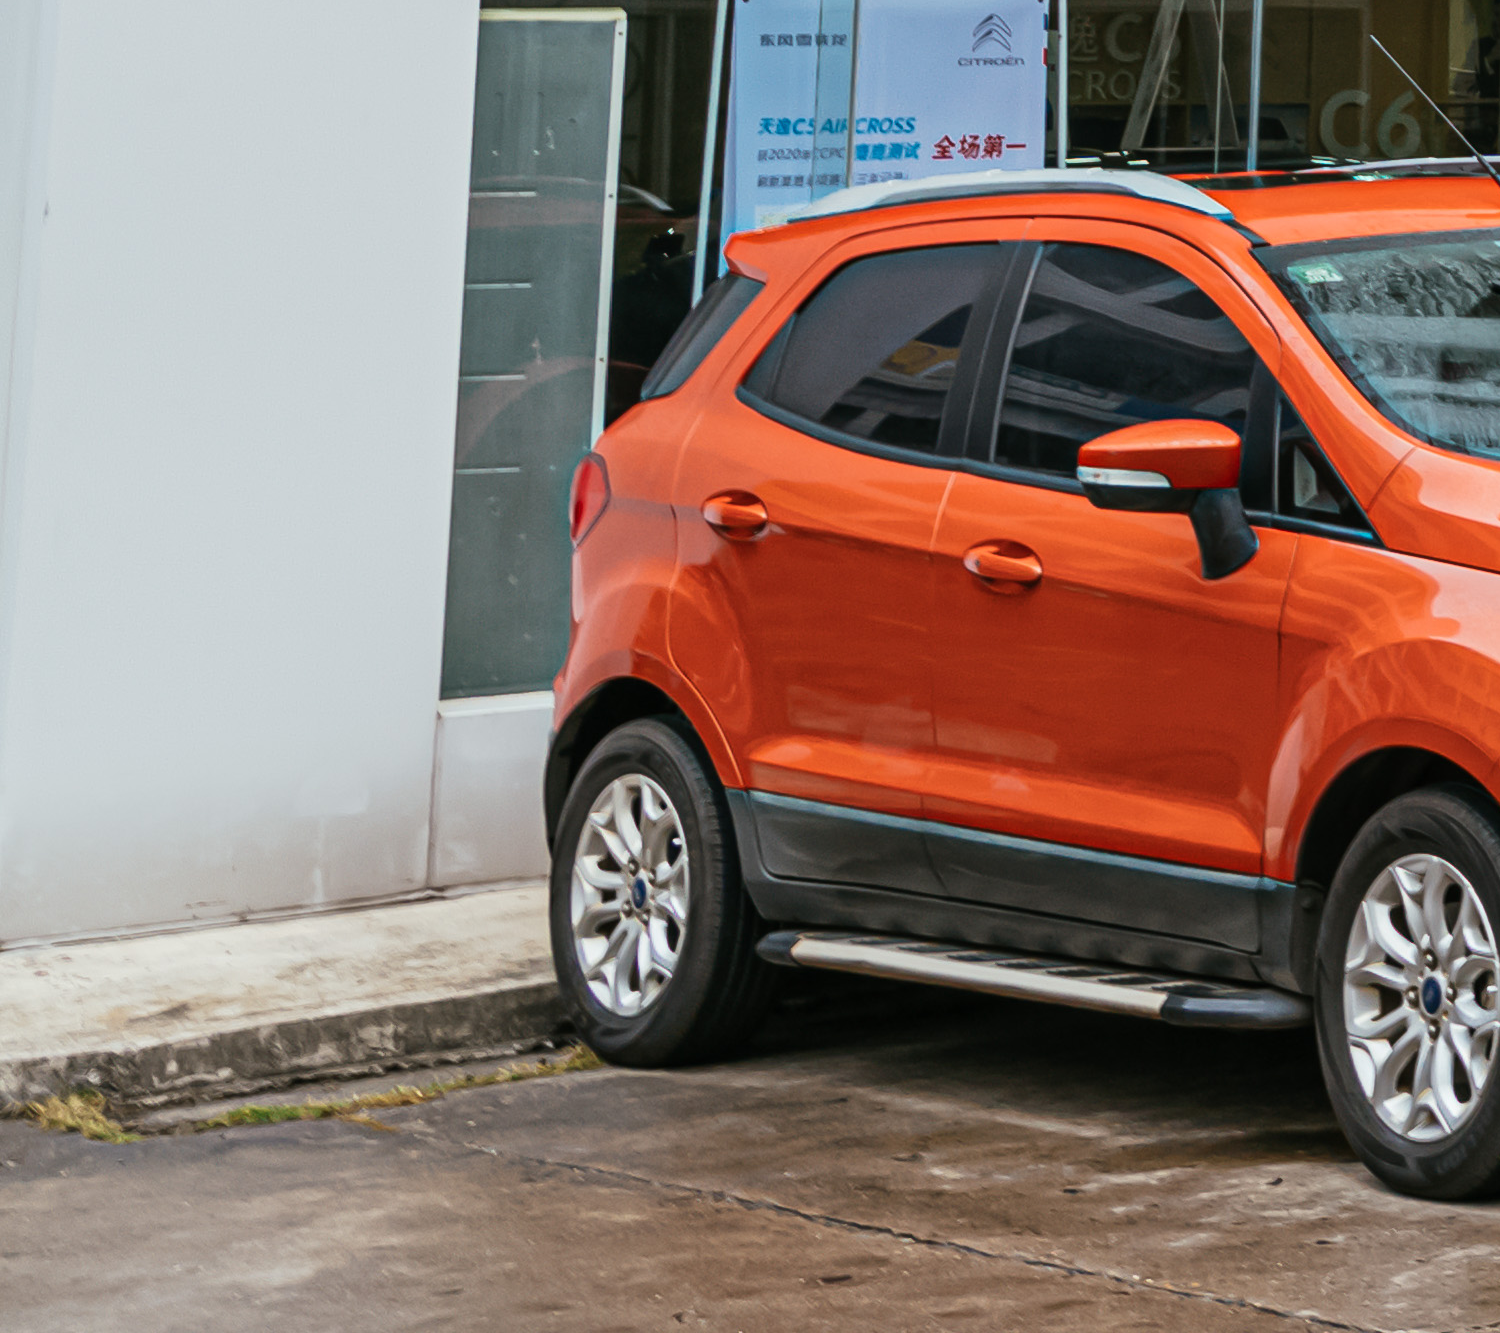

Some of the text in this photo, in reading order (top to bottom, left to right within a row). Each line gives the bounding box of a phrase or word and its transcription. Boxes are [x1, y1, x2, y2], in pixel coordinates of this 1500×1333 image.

[931, 134, 1027, 161] 全场第一
[1320, 89, 1422, 158] C6
